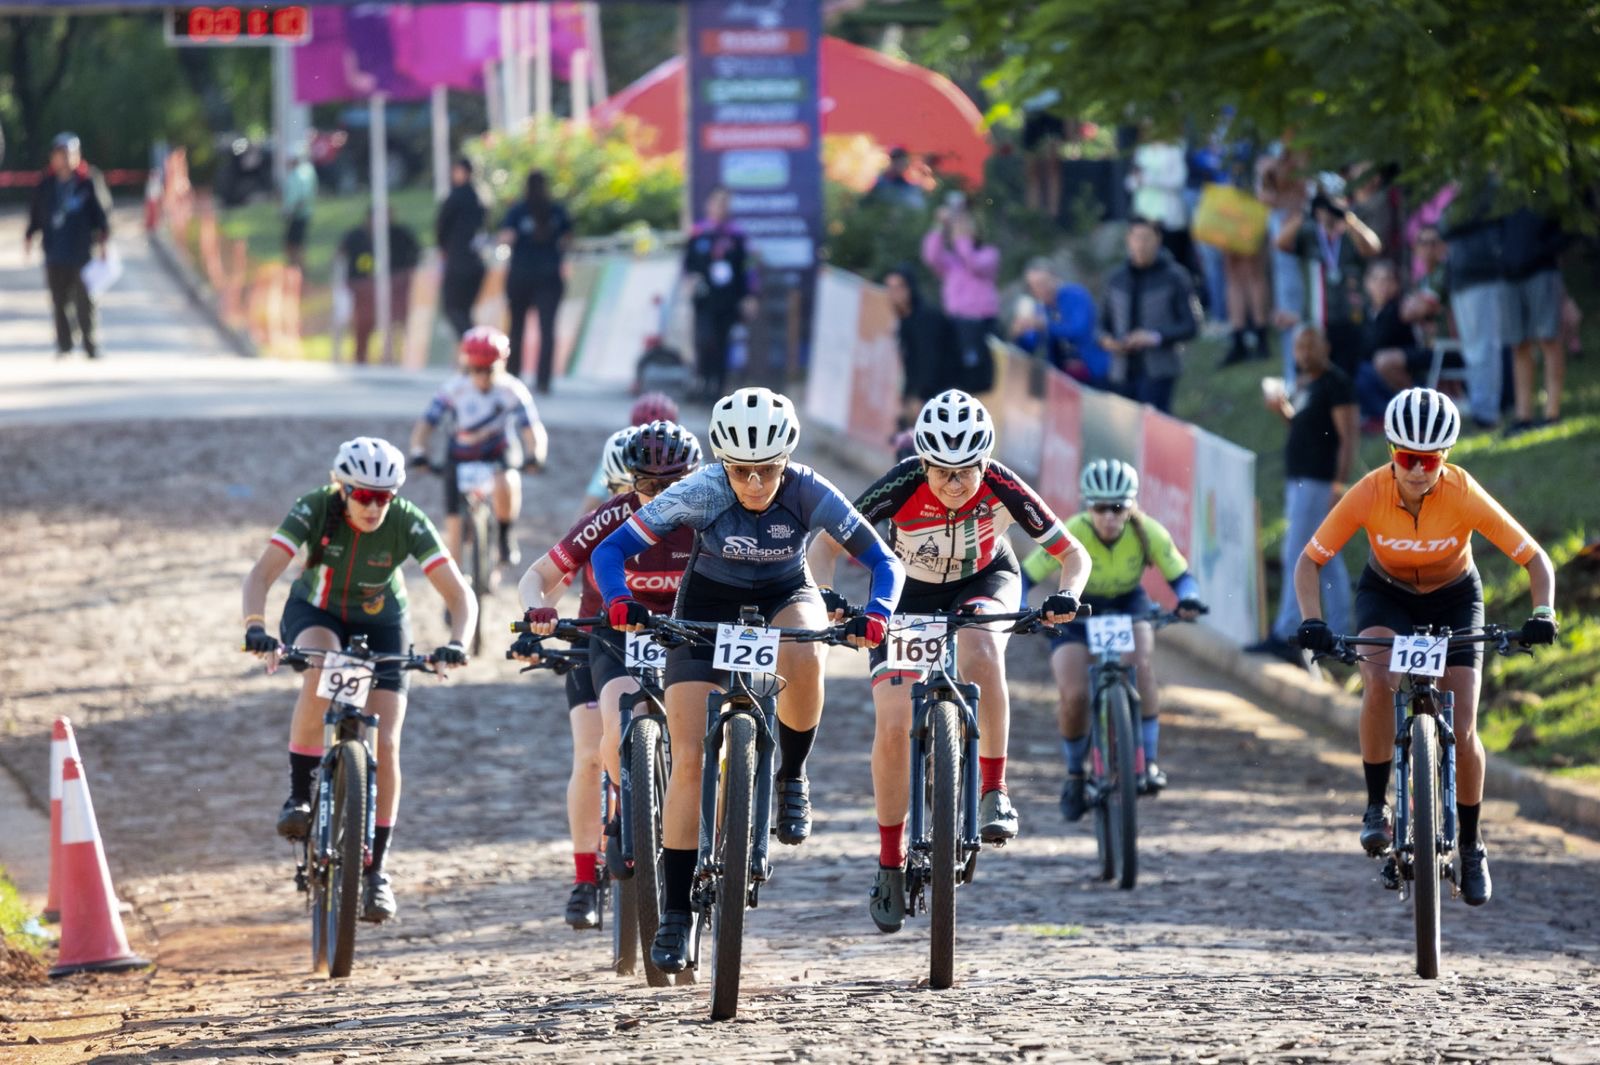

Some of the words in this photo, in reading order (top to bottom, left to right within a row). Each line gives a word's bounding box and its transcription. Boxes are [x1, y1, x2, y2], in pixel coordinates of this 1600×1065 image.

[573, 502, 634, 549] TOYOTA
[722, 544, 794, 557] Cyclesport
[1375, 534, 1459, 551] VOLTA
[892, 636, 942, 662] 169
[1093, 630, 1131, 648] 129
[719, 642, 774, 666] 126
[1397, 649, 1442, 670] 101
[328, 672, 360, 697] 99
